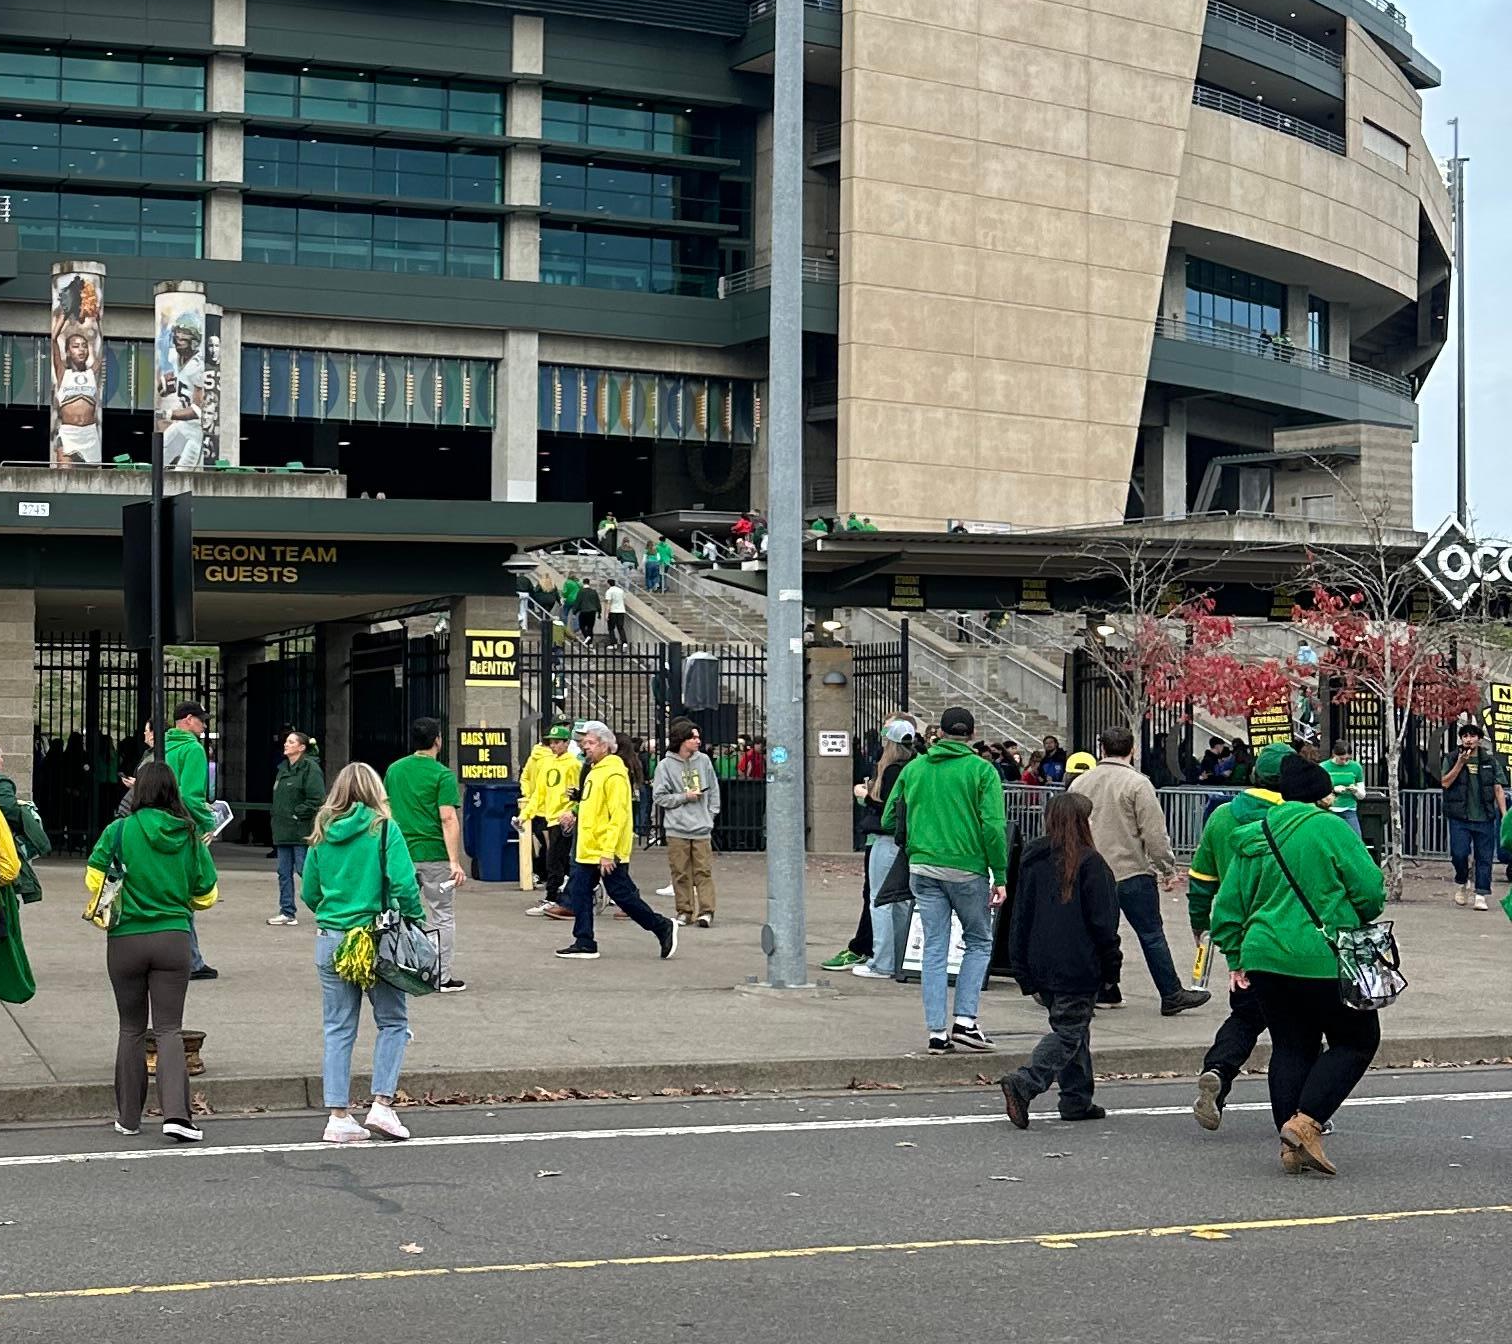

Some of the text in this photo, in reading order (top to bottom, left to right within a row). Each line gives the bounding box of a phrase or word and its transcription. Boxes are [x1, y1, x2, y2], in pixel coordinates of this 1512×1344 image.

[21, 504, 46, 515] 2745
[191, 545, 337, 563] REGON TEAM
[205, 566, 299, 583] GUESTS
[472, 640, 515, 658] NO
[461, 732, 507, 746] BAGS WILL
[478, 748, 490, 762] BE
[462, 765, 508, 779] INSPECTED
